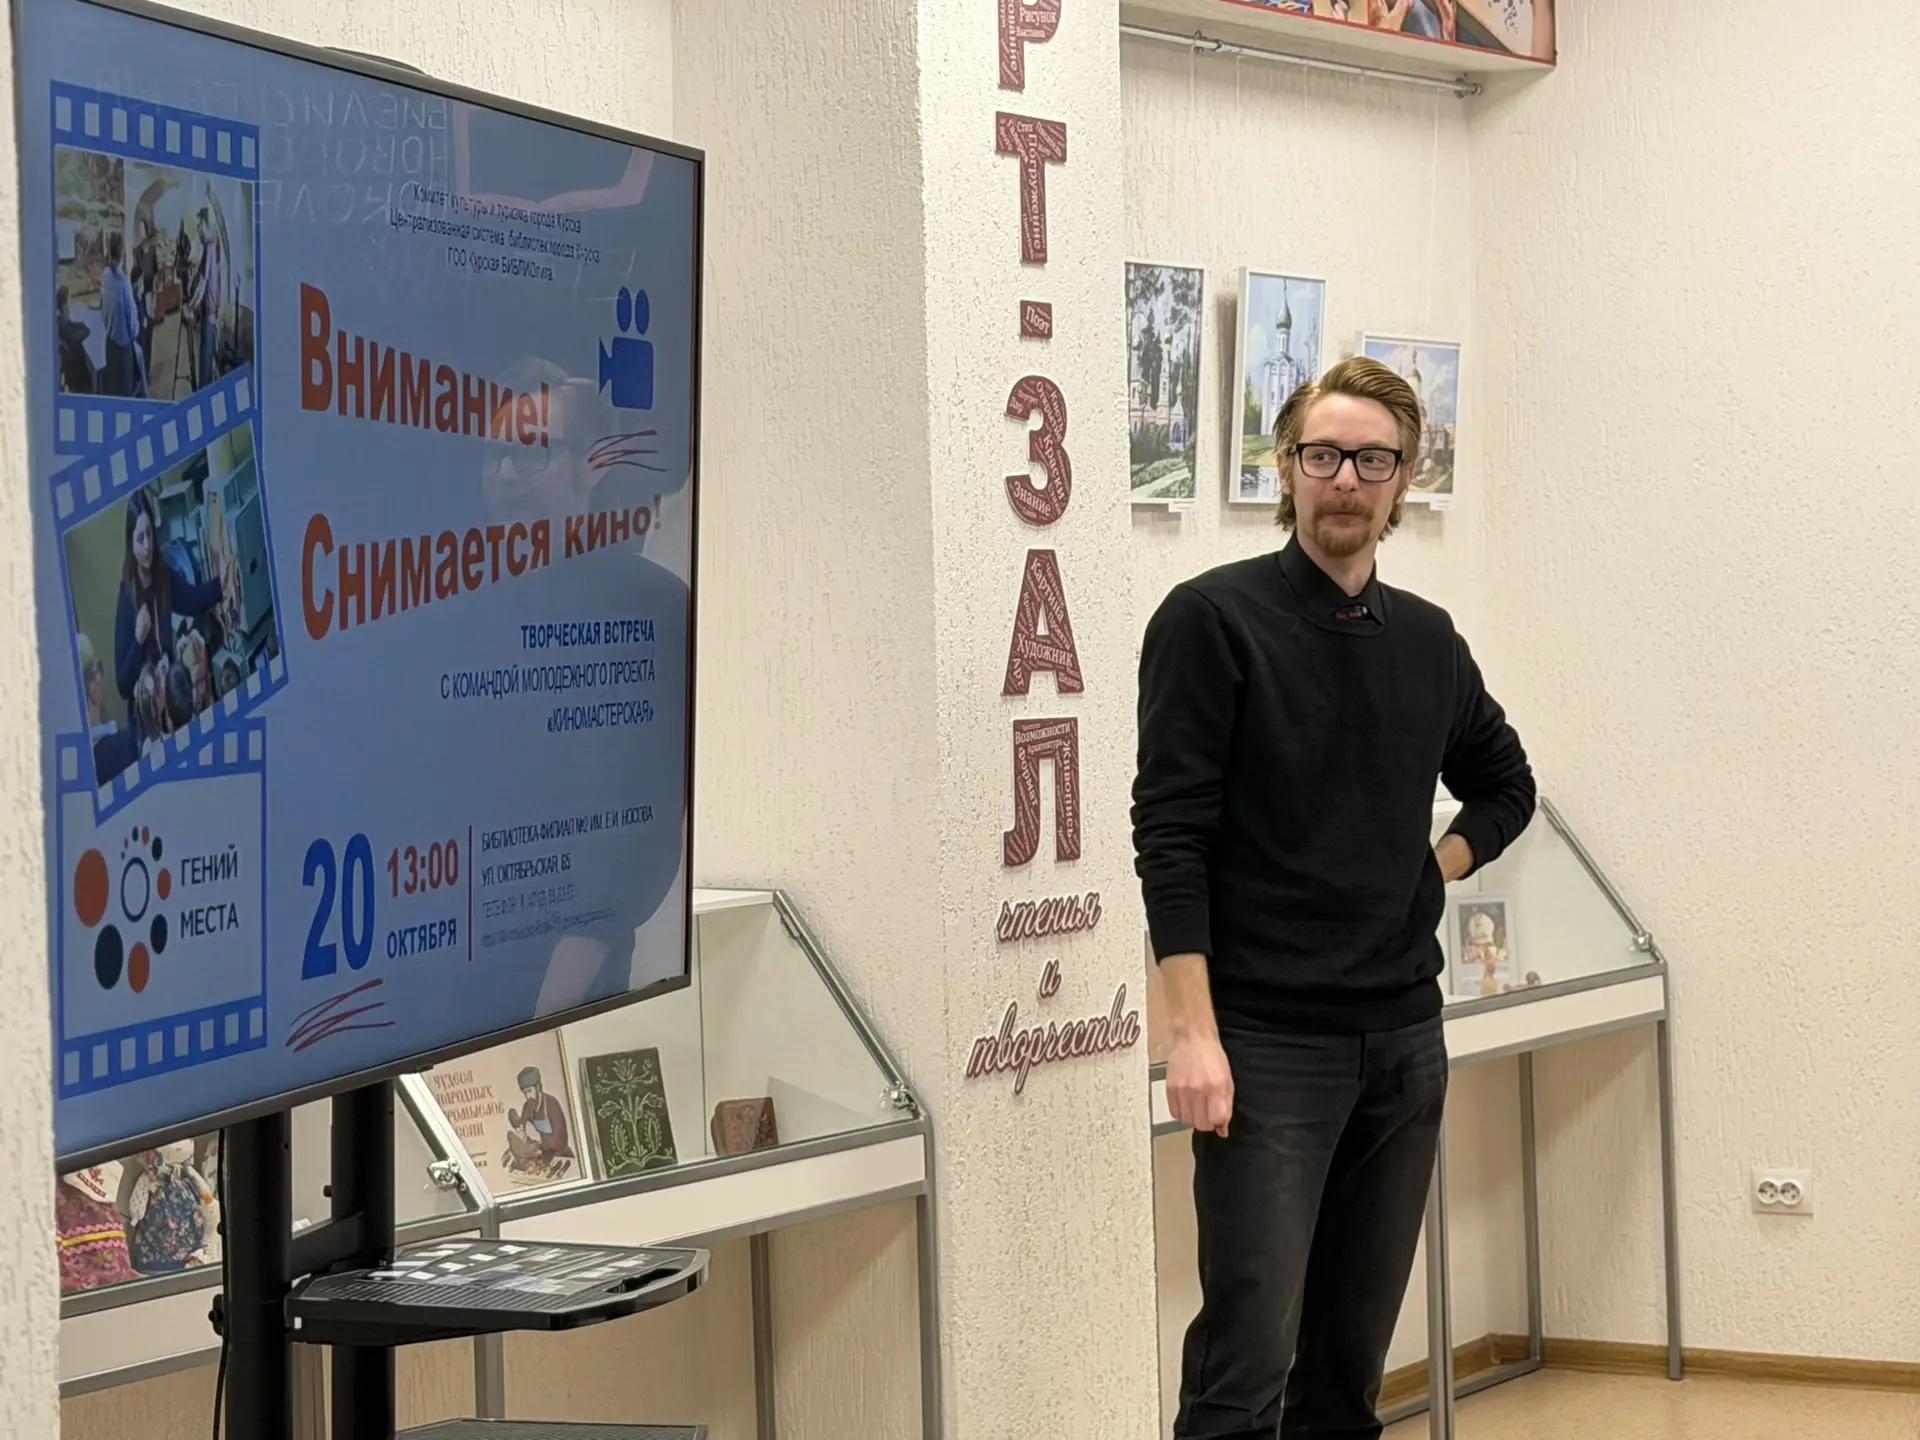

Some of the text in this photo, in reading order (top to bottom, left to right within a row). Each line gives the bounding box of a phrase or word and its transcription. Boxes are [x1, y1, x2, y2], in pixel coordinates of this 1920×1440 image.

[1028, 133, 1042, 250] Погружение
[1025, 305, 1050, 335] Поэт
[300, 281, 550, 448] Внимание!
[1036, 381, 1062, 442] Открытие
[1044, 434, 1064, 500] Краски
[1012, 481, 1051, 517] Знание
[302, 494, 662, 641] Снимается кино!
[1031, 558, 1064, 623] Картина
[521, 619, 655, 650] ТВОРЧЕСКАЯ ВСТРЕЧА
[1016, 633, 1073, 670] Художник
[441, 659, 655, 700] С КОМАНДОЙ МОЛОДЕЖНОГО ПРОЕКТА
[1012, 657, 1025, 690] Арт
[547, 700, 654, 732] «КИНОМАСТЕРСКАЯ»
[1018, 746, 1039, 808] Формат
[1062, 740, 1076, 839] Живопись
[181, 844, 238, 887] ГЕНИЙ
[387, 839, 459, 898] 13:00
[181, 902, 239, 939] МЕСТА
[301, 833, 375, 981] 20
[997, 892, 1102, 942] чтения
[387, 918, 457, 959] ОКТЯБРЯ
[1038, 959, 1062, 999] и
[965, 984, 1140, 1098] творчества
